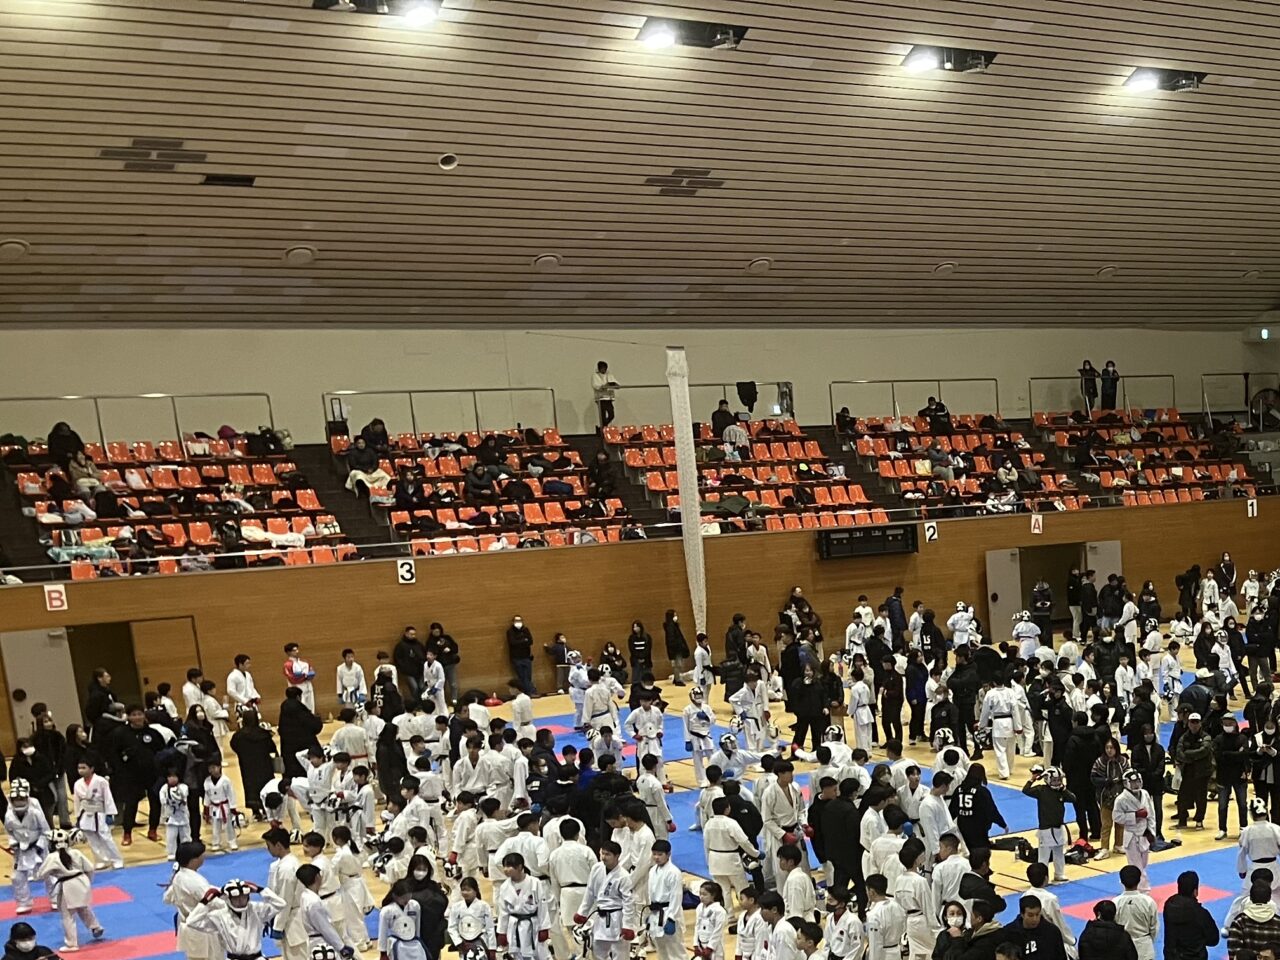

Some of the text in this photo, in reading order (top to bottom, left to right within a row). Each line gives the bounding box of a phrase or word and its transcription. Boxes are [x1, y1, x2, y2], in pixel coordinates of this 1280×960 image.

[926, 525, 938, 541] 2
[1032, 518, 1042, 533] A
[400, 562, 415, 581] 3
[47, 590, 65, 608] B
[958, 794, 973, 808] 15
